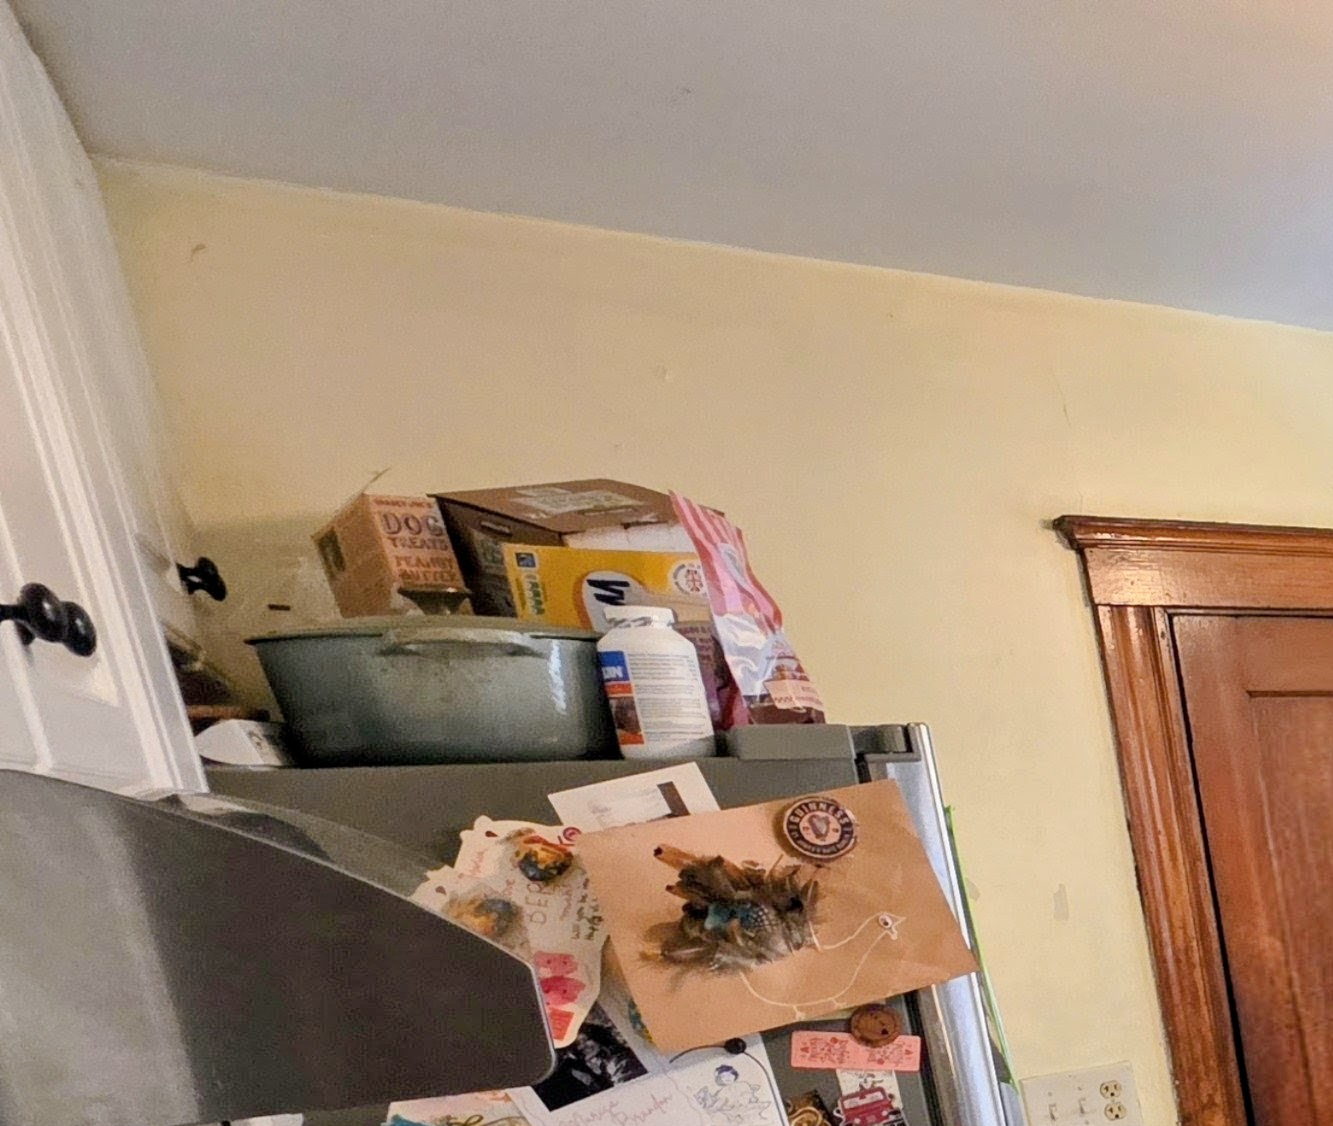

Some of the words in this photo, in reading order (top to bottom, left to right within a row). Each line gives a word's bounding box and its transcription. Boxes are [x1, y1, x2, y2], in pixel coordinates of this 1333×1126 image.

[383, 512, 444, 537] DOG
[387, 537, 448, 551] TREATS
[394, 555, 454, 569] PEANUT
[398, 569, 457, 582] BUTTER
[789, 801, 850, 824] GUINNESS
